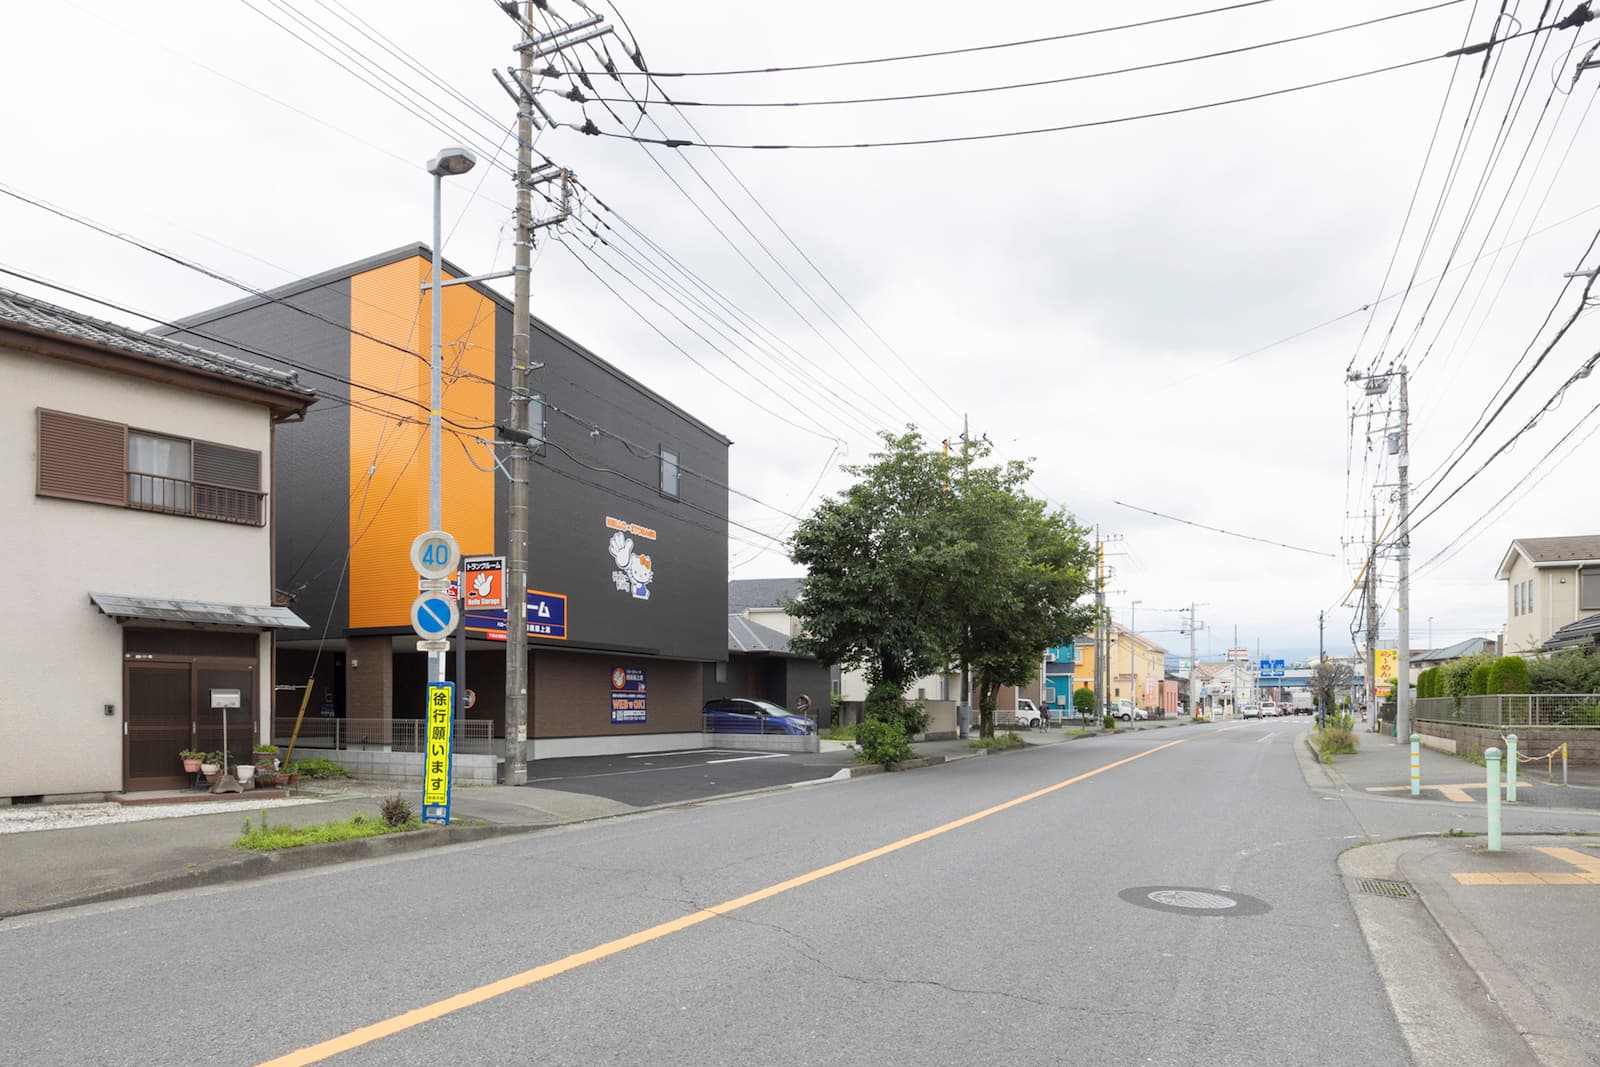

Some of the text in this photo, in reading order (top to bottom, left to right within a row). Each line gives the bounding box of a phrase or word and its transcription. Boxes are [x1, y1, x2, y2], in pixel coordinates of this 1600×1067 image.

[422, 544, 449, 566] 40
[467, 562, 501, 571] トランクルーム
[431, 692, 448, 791] 徐行願います
